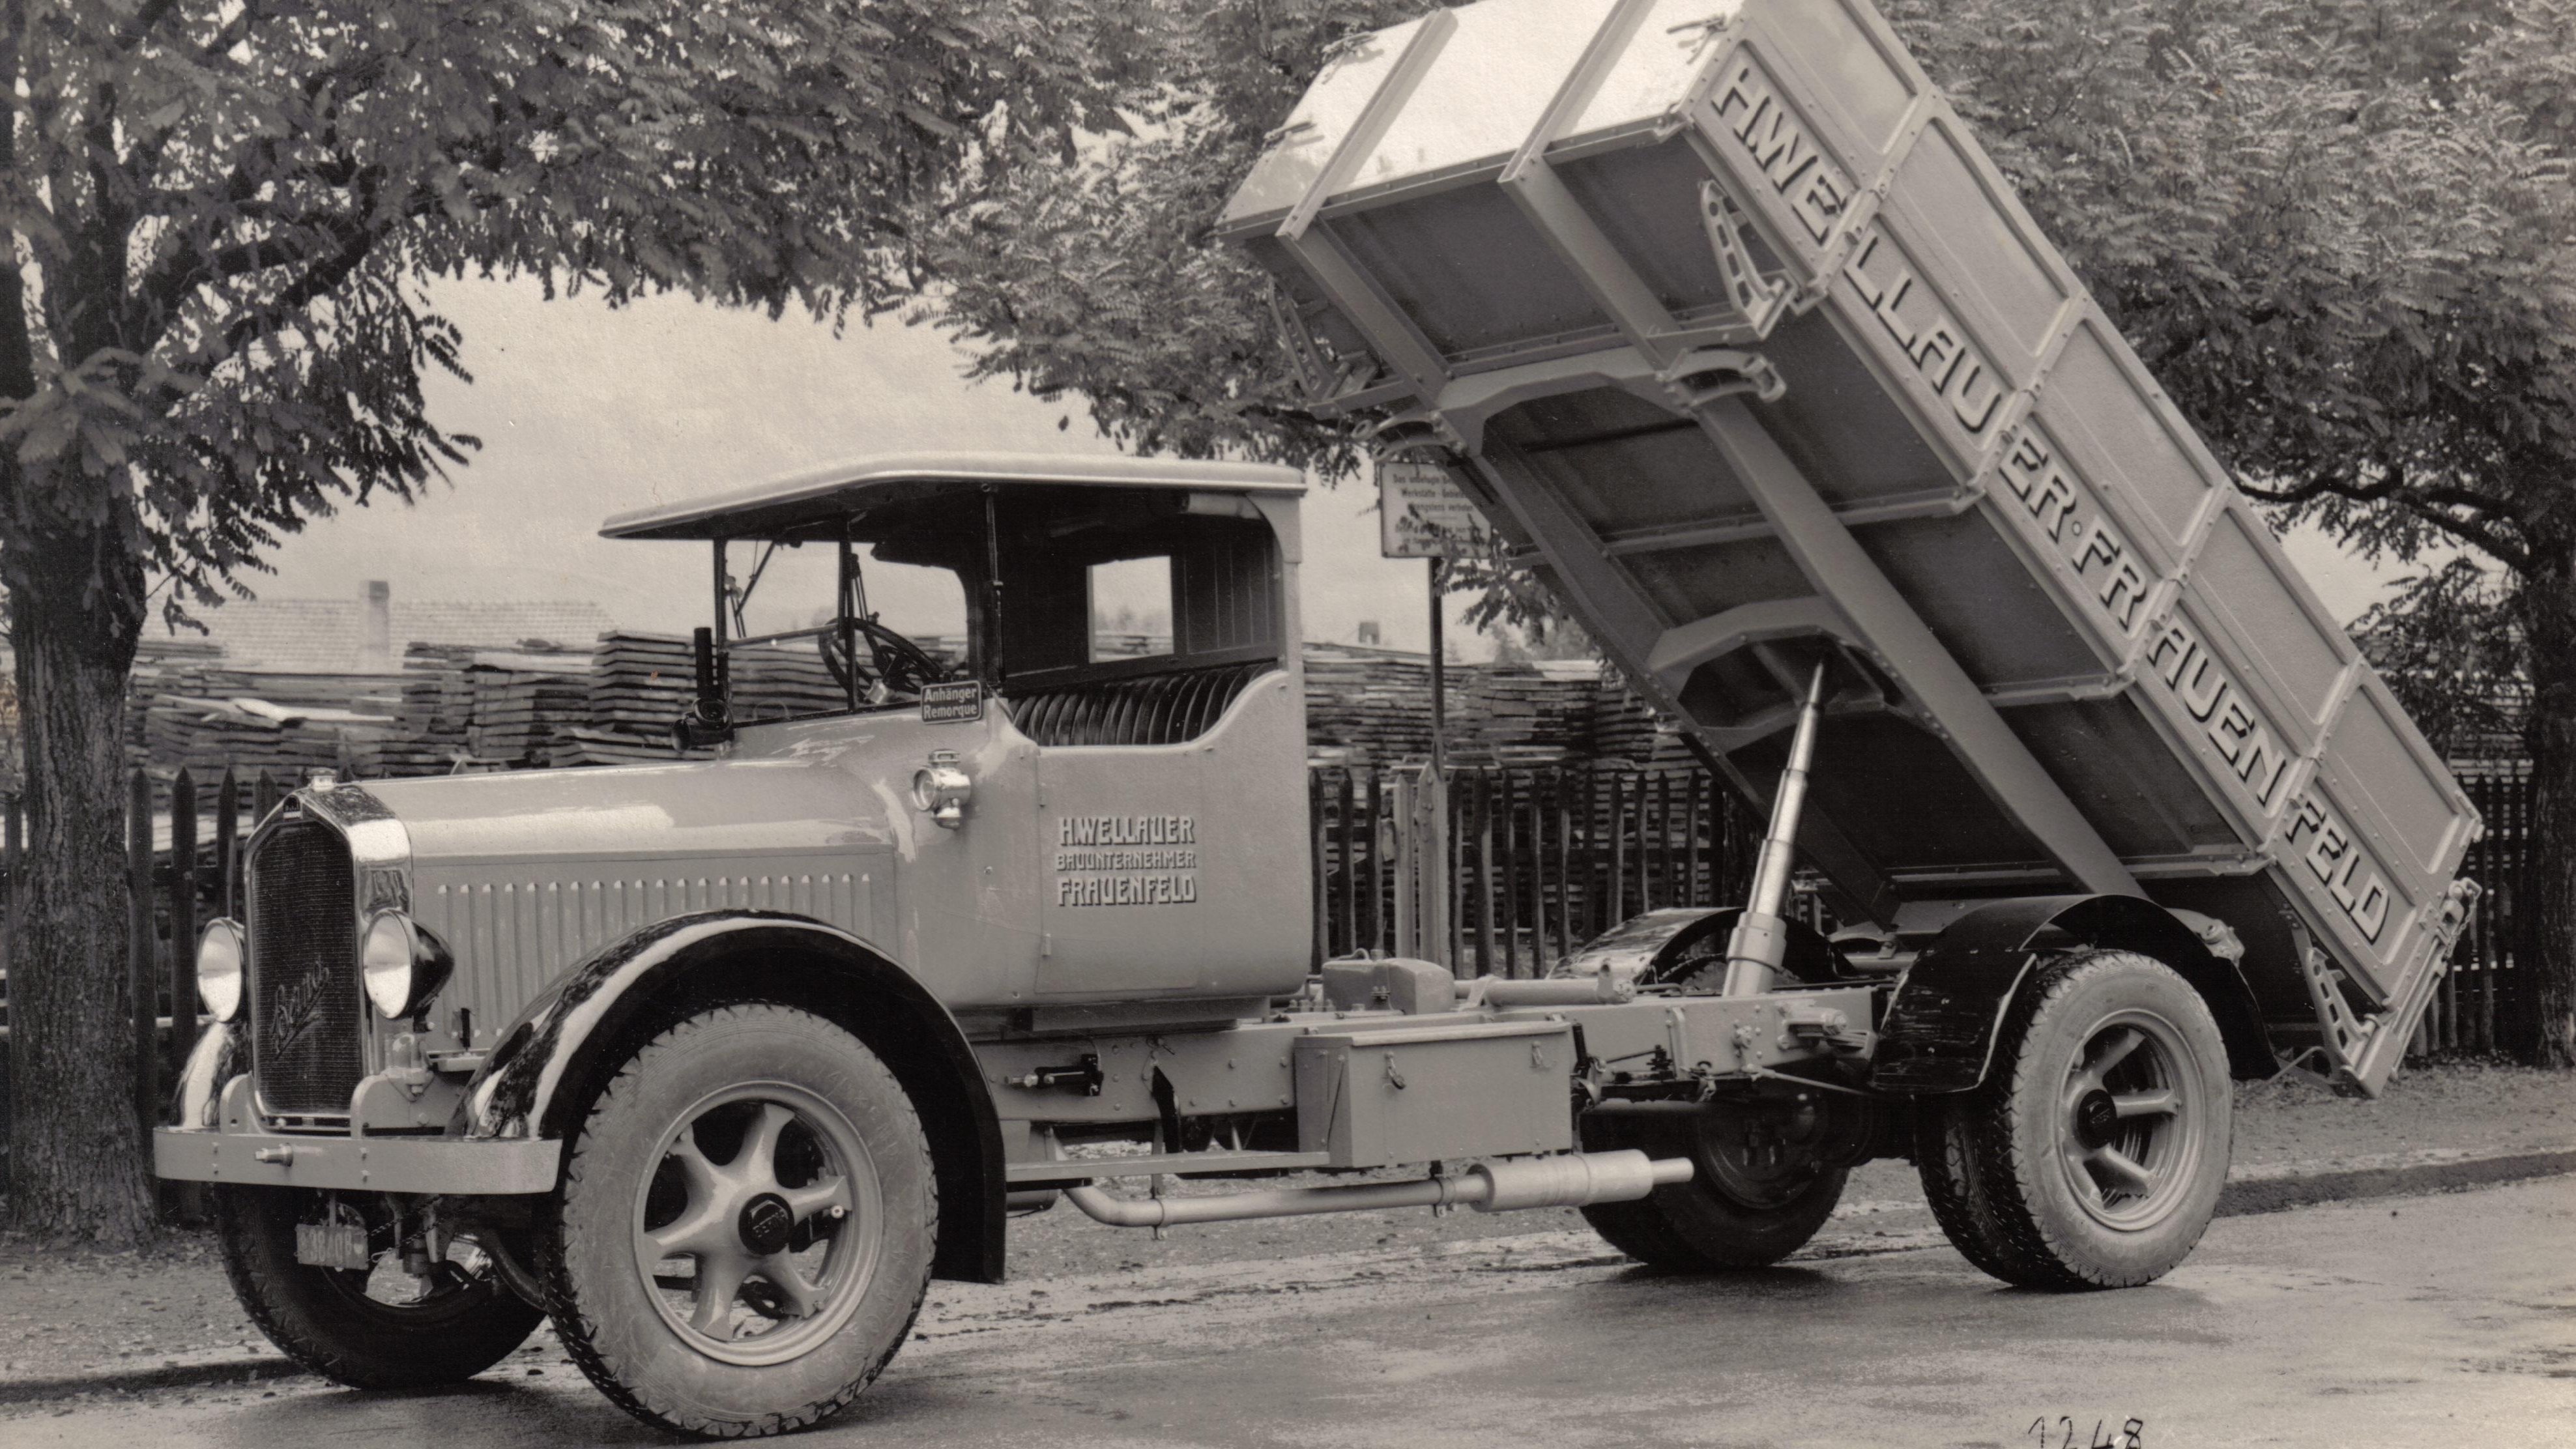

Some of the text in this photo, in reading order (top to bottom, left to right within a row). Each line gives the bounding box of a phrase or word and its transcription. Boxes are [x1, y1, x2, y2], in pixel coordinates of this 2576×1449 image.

[924, 688, 977, 704] Anhänger
[923, 704, 977, 719] Remorque
[1056, 850, 1196, 871] BAUUNTERNEHMER
[1057, 876, 1196, 906] FRAUENFELD
